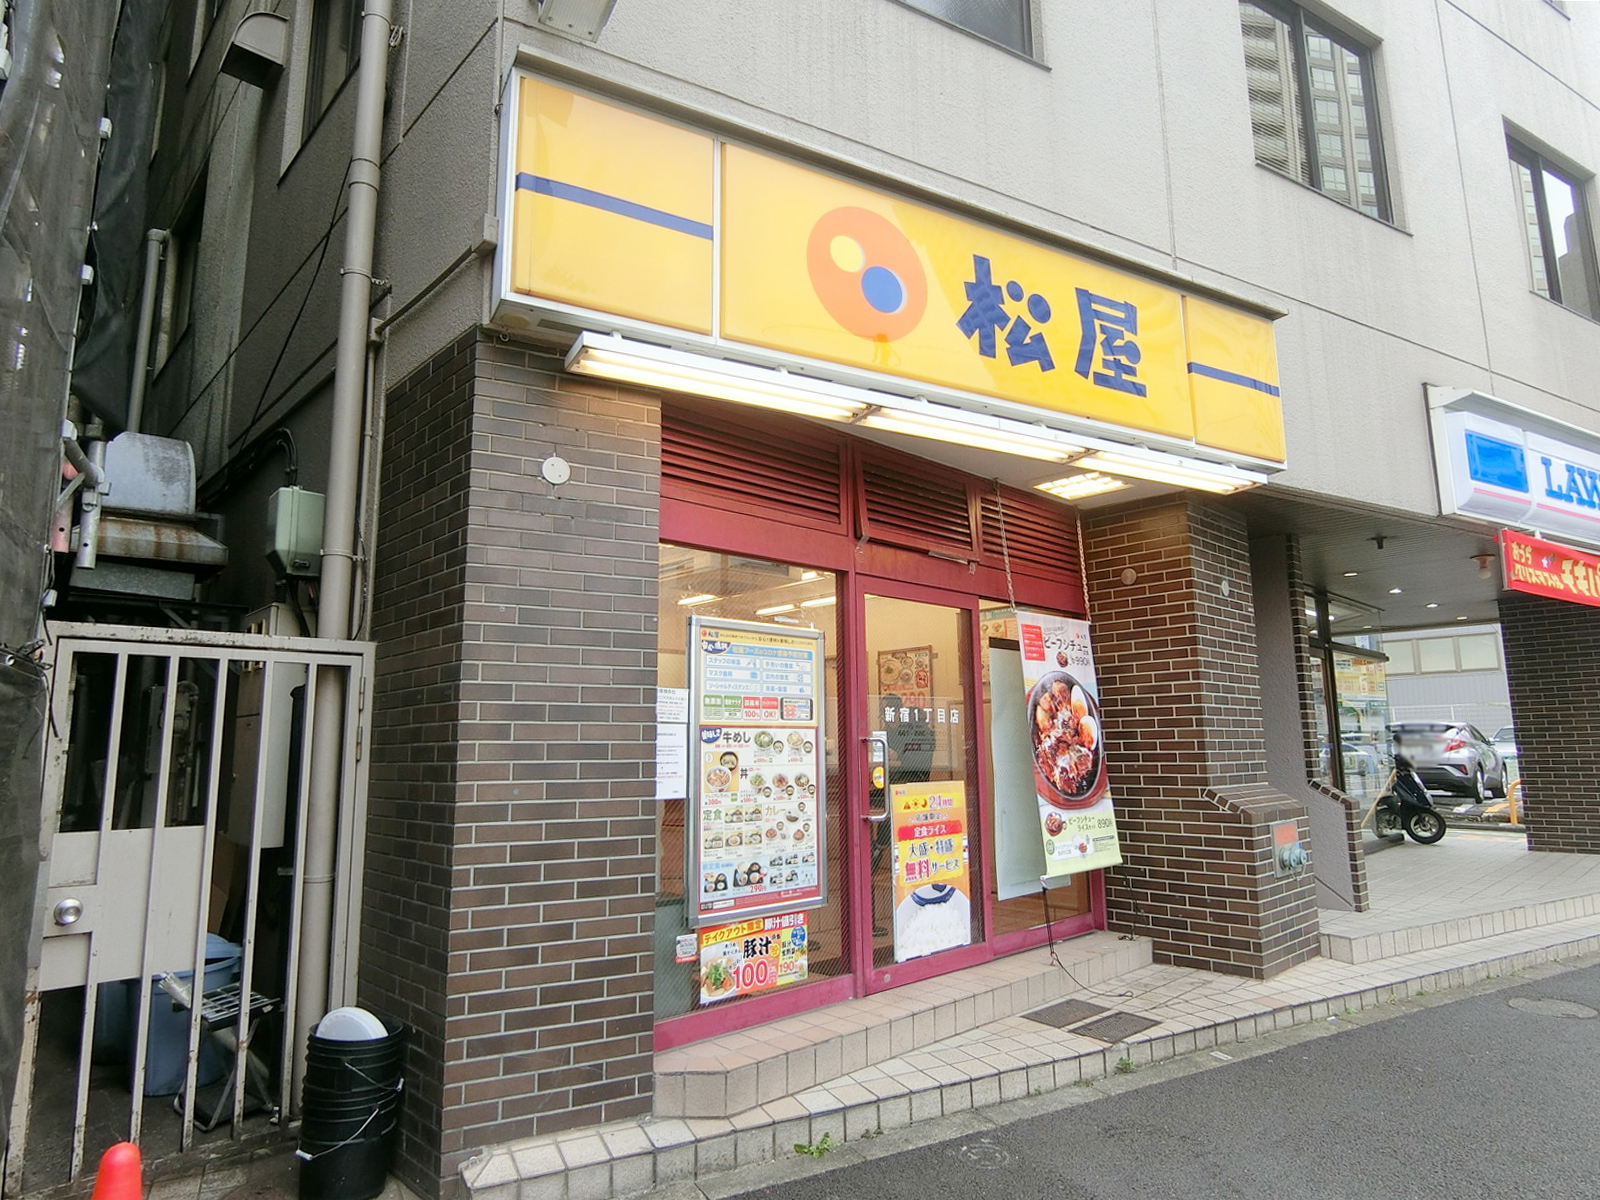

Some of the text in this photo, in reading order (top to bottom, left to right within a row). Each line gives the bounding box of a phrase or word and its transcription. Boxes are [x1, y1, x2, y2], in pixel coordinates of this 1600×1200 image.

[956, 254, 1147, 398] 松屋
[884, 707, 959, 724] 新宿1丁目店
[723, 731, 751, 743] 牛めし
[740, 768, 748, 779] 丼
[703, 809, 722, 821] 定食
[765, 806, 786, 816] カレー
[914, 824, 947, 838] 定食ライス
[905, 858, 959, 882] 無料サービス
[704, 920, 762, 944] テイクアウト限定
[743, 936, 772, 959] 豚汁
[733, 959, 769, 989] 100
